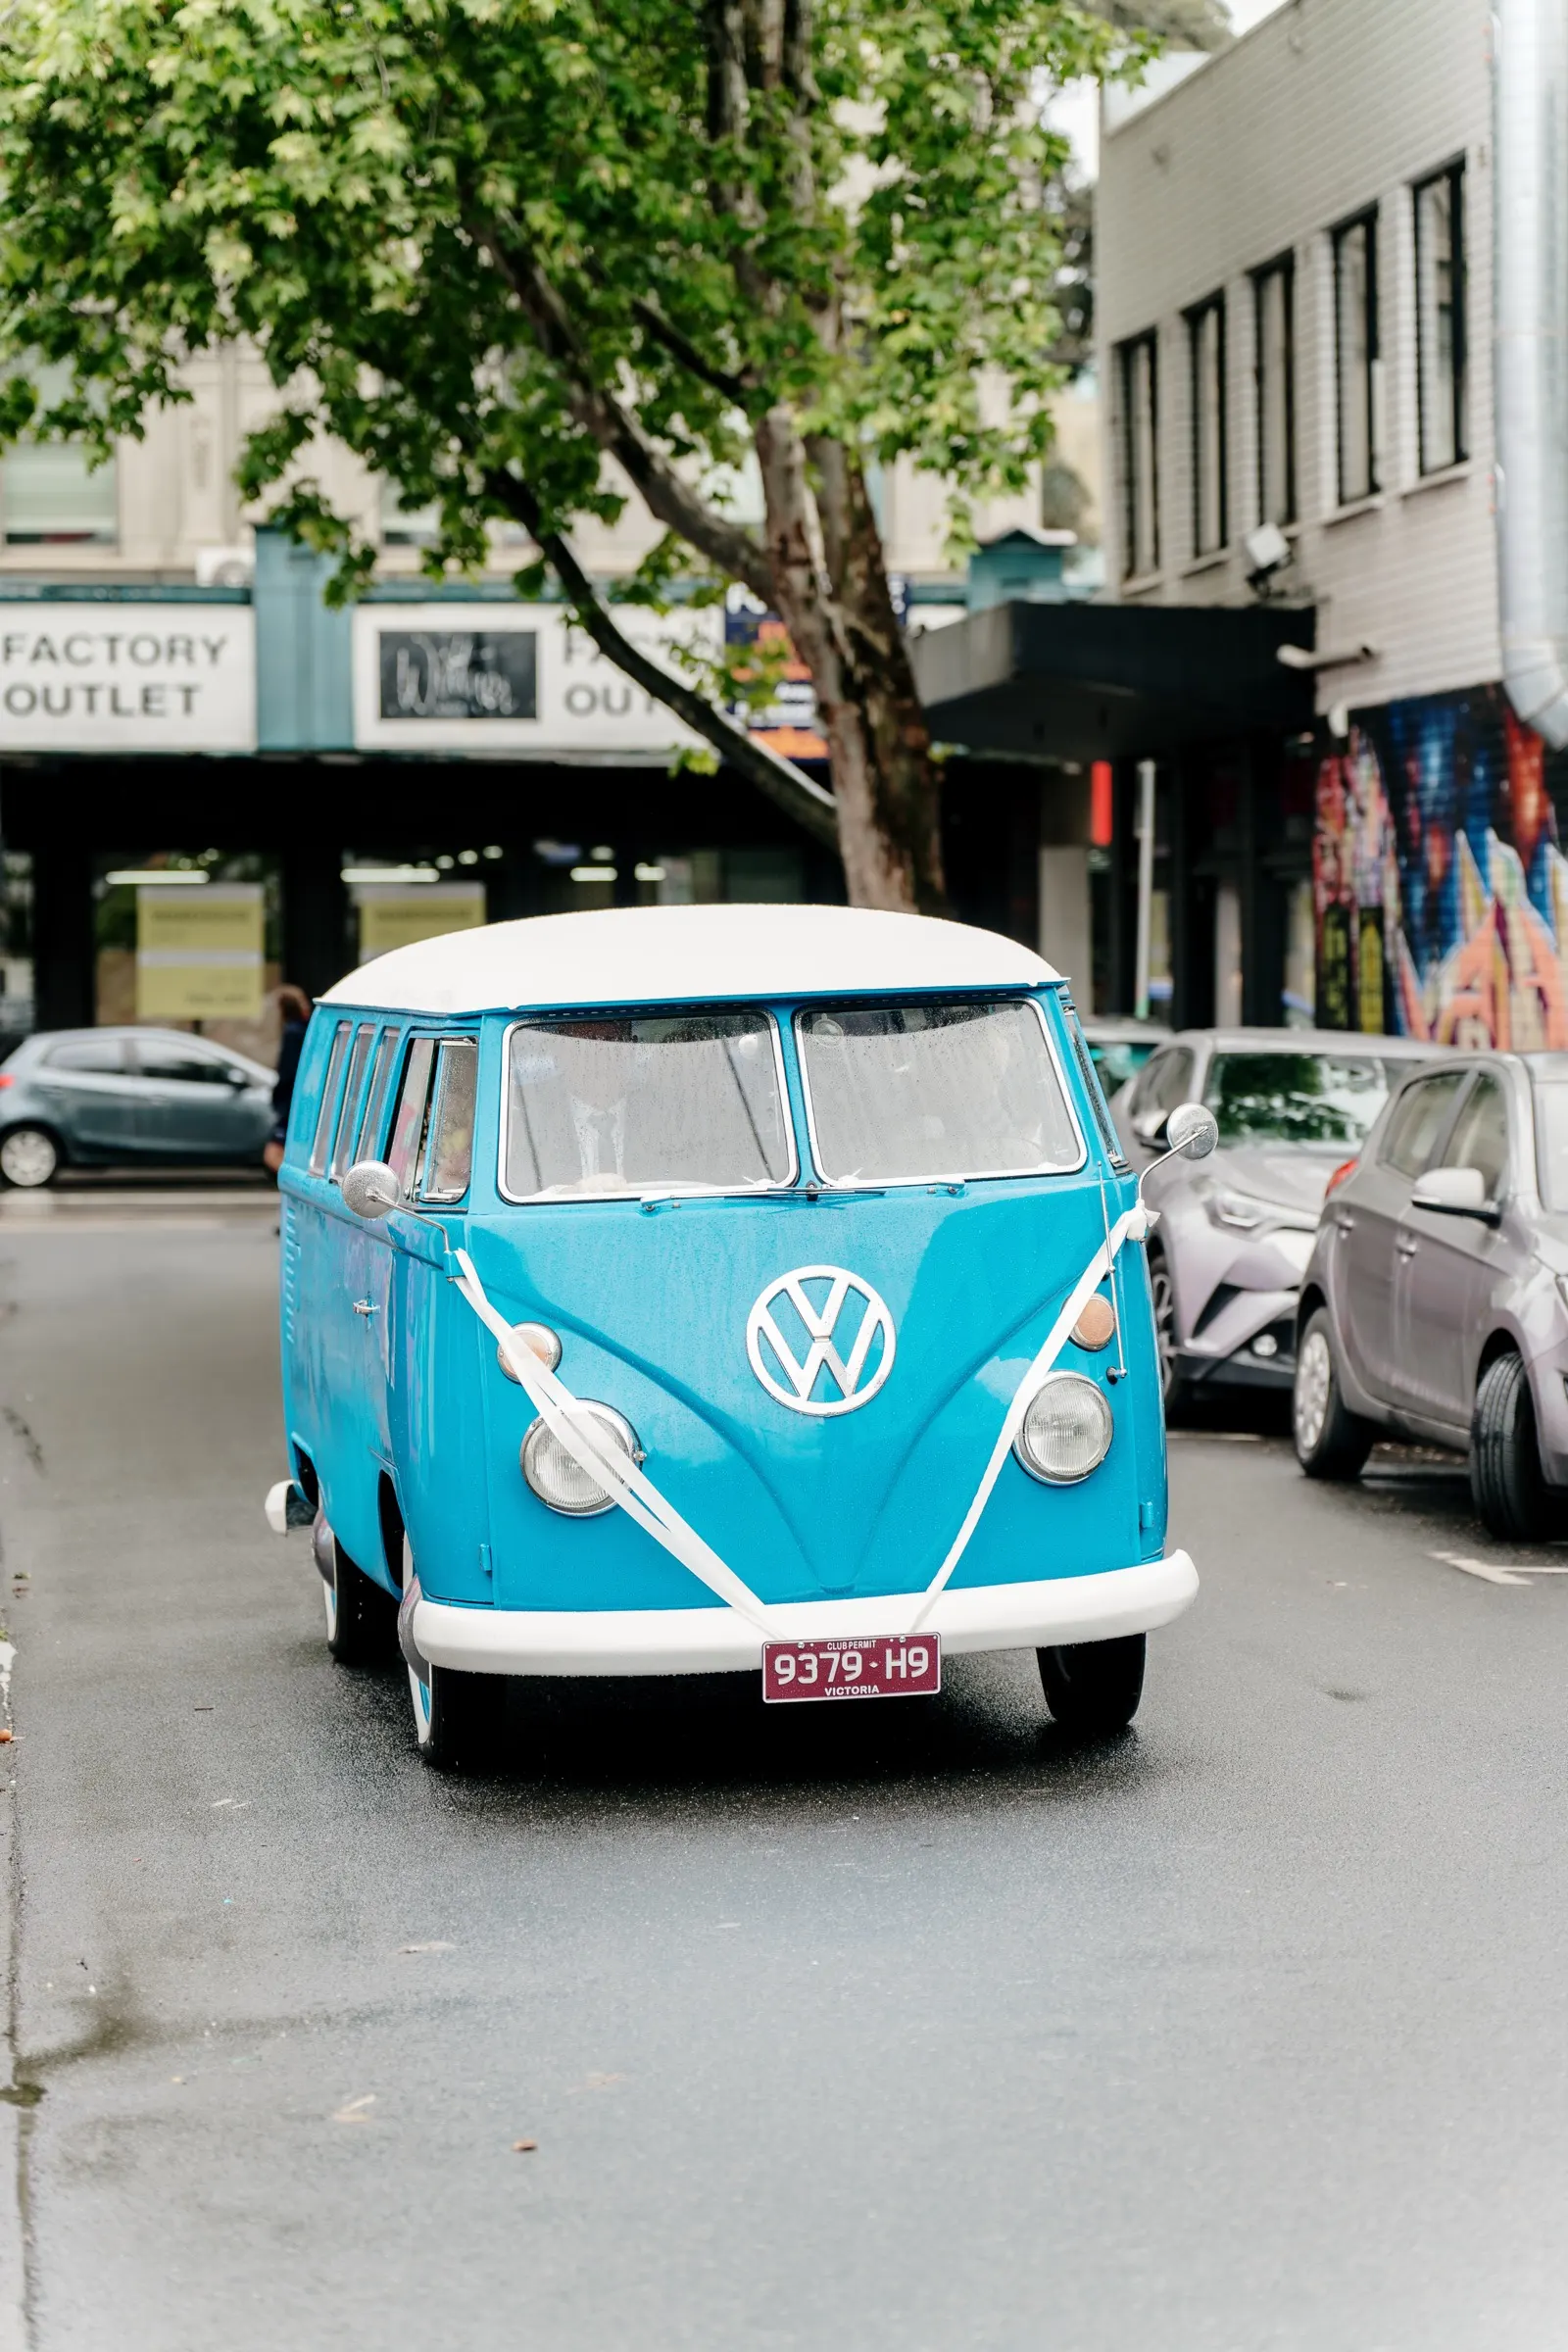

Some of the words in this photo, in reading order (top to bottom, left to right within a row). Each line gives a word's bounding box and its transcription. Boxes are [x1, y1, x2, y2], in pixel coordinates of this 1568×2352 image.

[3, 632, 227, 666] FACTORY
[4, 683, 201, 716] OUTLET
[751, 1270, 891, 1410] VW
[827, 1642, 848, 1651] CLUB
[848, 1640, 877, 1650] PERMIT
[824, 1685, 880, 1696] VICTORIA
